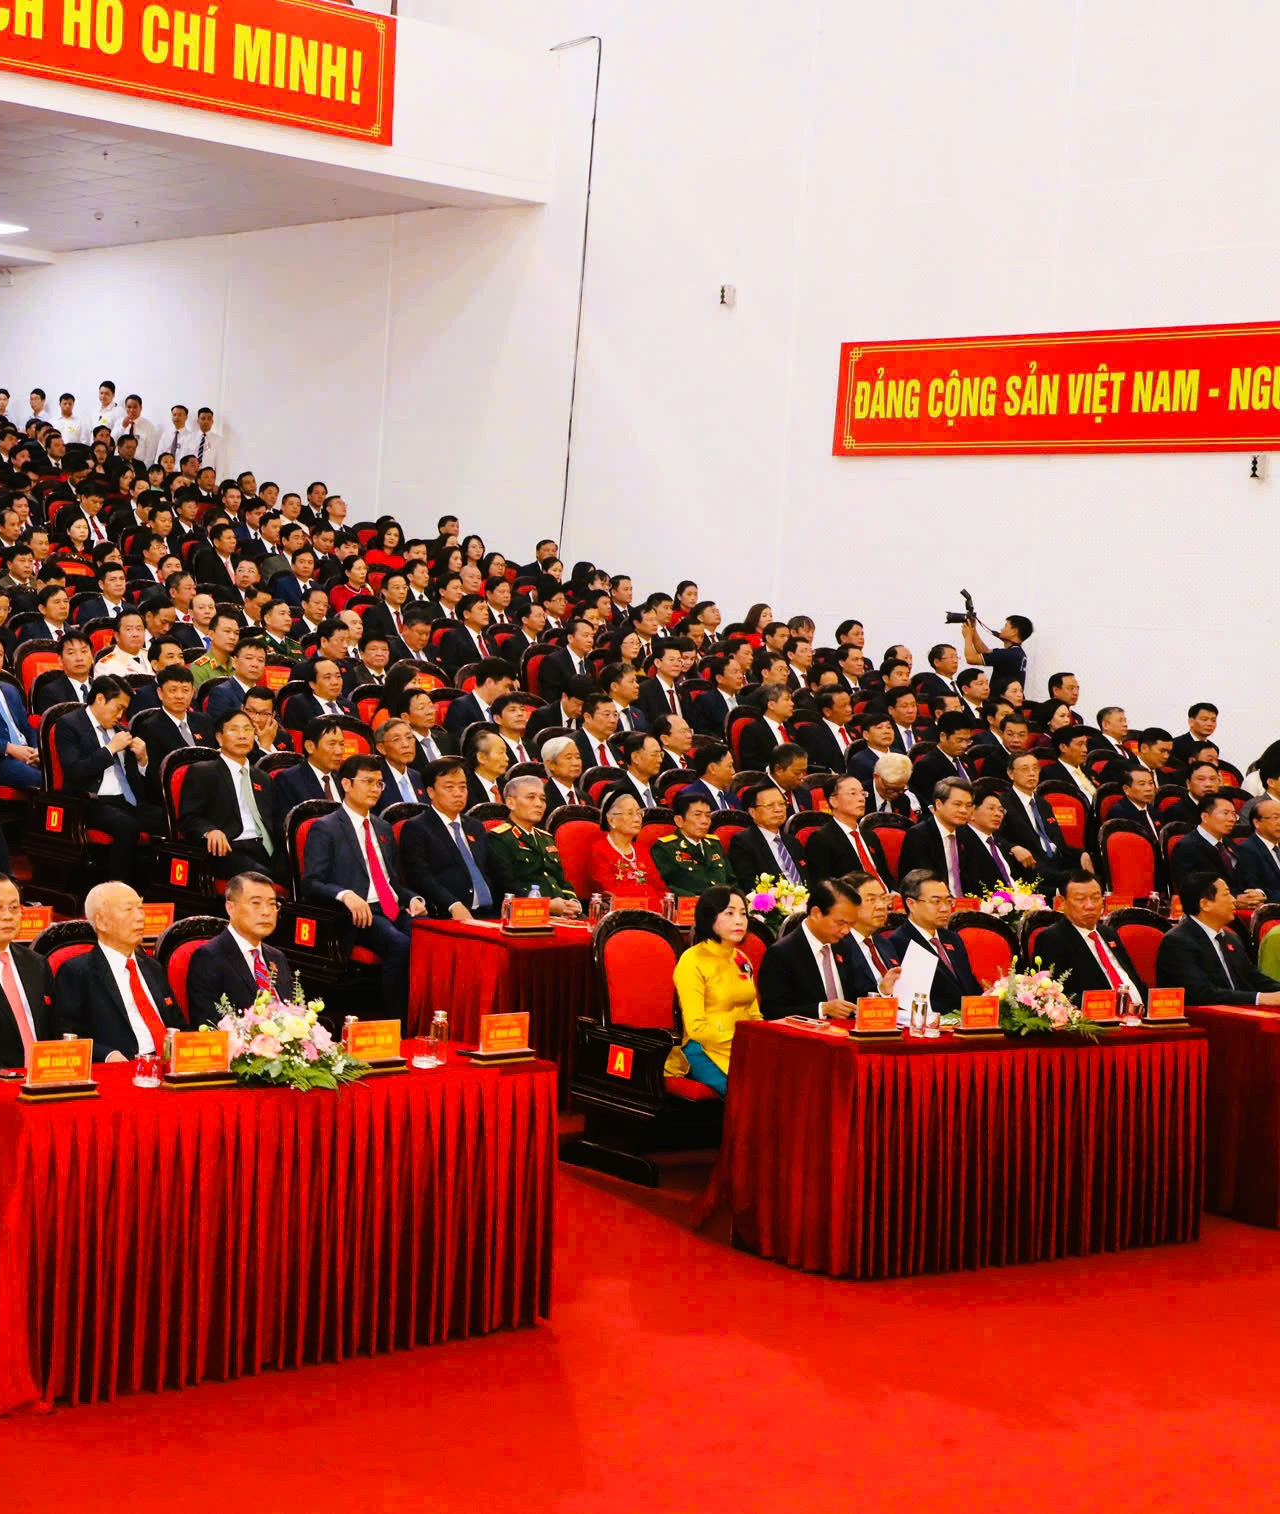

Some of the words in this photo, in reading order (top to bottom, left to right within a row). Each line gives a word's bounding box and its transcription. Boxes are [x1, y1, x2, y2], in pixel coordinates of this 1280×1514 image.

[142, 5, 218, 74] CHÍ
[233, 23, 363, 105] MINH!
[854, 367, 921, 420] ĐẢNG
[927, 369, 997, 427] CỘNG
[1004, 361, 1062, 417] SẢN
[1068, 363, 1125, 424] VIỆT
[1131, 369, 1200, 413] NAM
[175, 863, 184, 881] C
[300, 923, 310, 941] B
[614, 1051, 625, 1072] A
